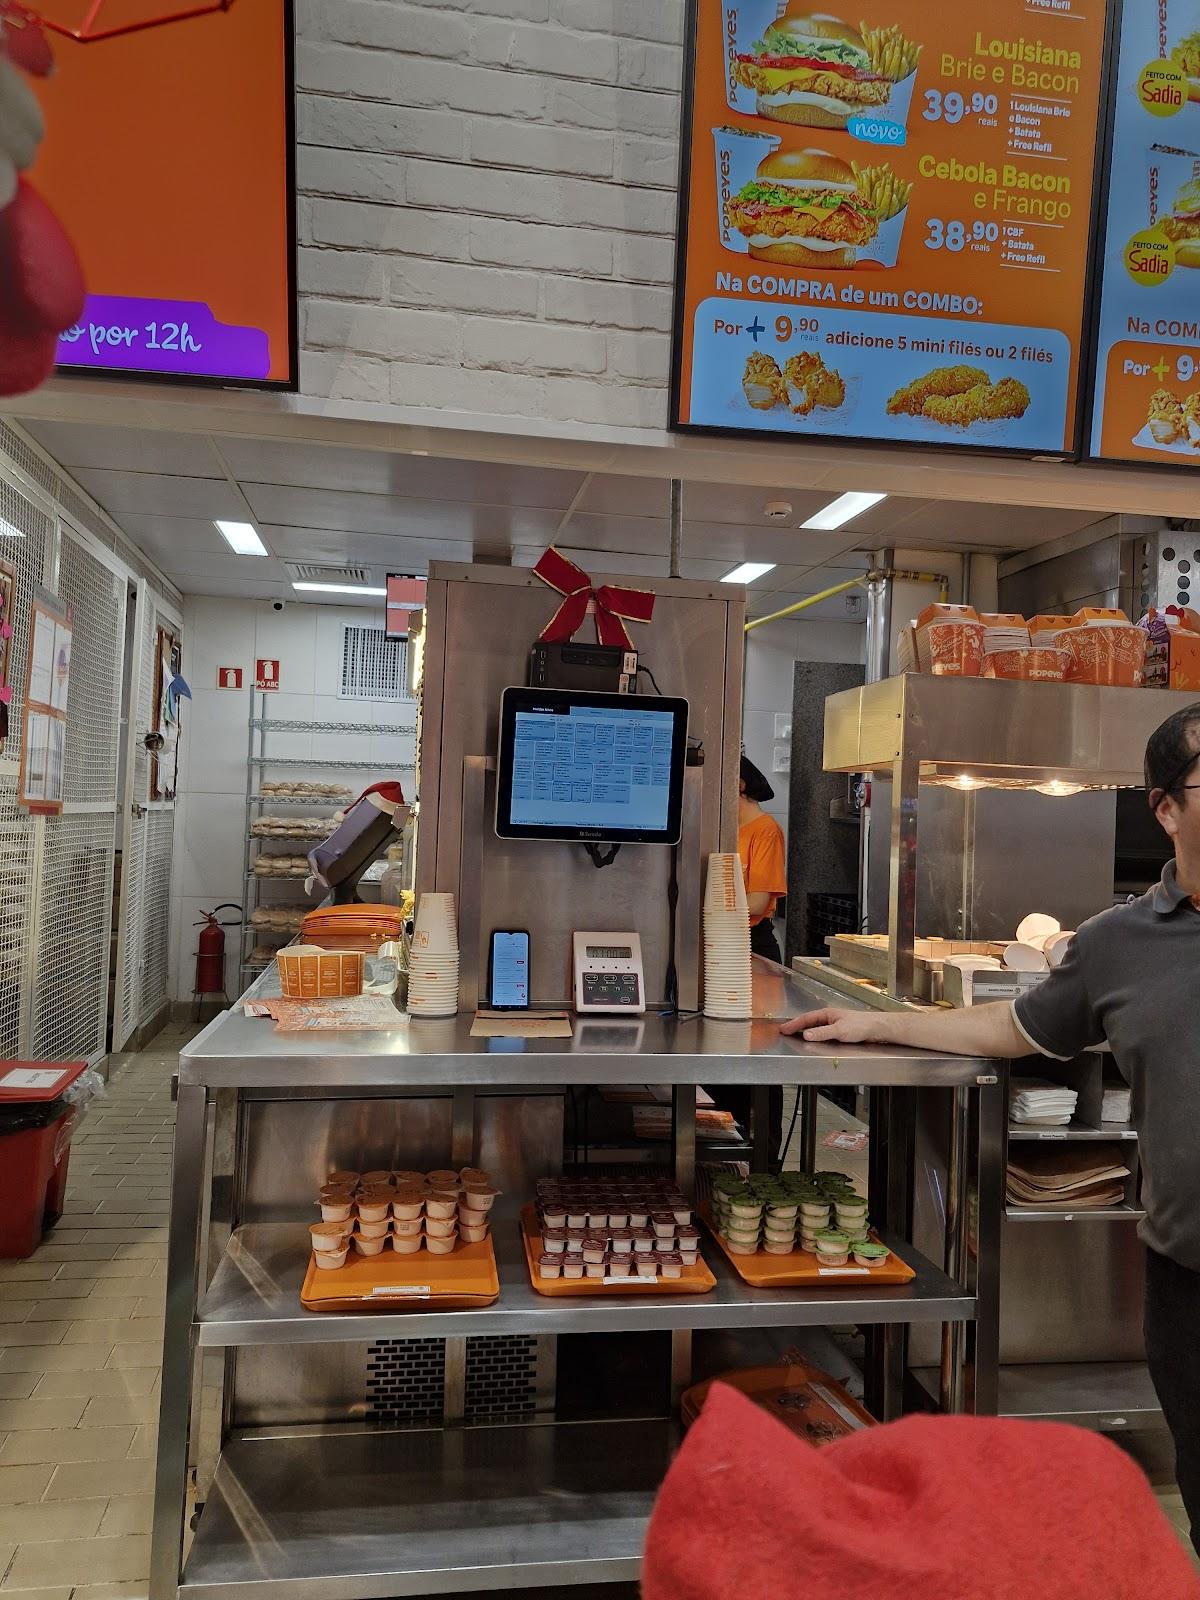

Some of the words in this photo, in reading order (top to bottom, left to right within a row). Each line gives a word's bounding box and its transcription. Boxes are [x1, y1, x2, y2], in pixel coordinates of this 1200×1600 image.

[975, 31, 1082, 70] Louisiana
[940, 53, 986, 81] Brie
[992, 66, 1005, 83] e
[1011, 64, 1080, 94] Bacon
[1146, 71, 1165, 79] FEITO
[1165, 73, 1182, 81] COM
[1142, 79, 1182, 105] Sadia
[921, 88, 998, 125] 39,90
[1009, 101, 1014, 110] 1
[1014, 101, 1053, 116] Louisiana
[1054, 107, 1071, 118] Brie
[855, 121, 902, 141] novo
[978, 117, 998, 127] reais
[1015, 114, 1041, 126] Bacon
[1014, 127, 1041, 139] Batata
[1013, 139, 1033, 150] Free
[1033, 141, 1052, 152] Refil
[918, 154, 998, 186] Cebola
[1002, 164, 1071, 194] Bacon
[973, 191, 987, 209] e
[993, 188, 1072, 221] Frango
[924, 218, 999, 252] 38,90
[1007, 227, 1024, 237] CBF
[970, 243, 990, 252] reais
[1007, 240, 1034, 251] Batata
[1133, 241, 1152, 249] FEITO
[1152, 243, 1169, 251] COM
[1007, 251, 1026, 263] Free
[1026, 253, 1045, 264] Refil
[1129, 250, 1169, 275] Sadia
[716, 271, 743, 292] Na
[747, 275, 837, 301] COMPRA
[840, 285, 865, 304] de
[868, 290, 899, 307] um
[903, 290, 983, 316] COMBO:
[89, 322, 139, 355] por
[145, 321, 202, 353] 12h
[714, 319, 743, 336] Por
[774, 315, 819, 343] 9,90
[800, 334, 819, 342] reais
[1127, 316, 1150, 335] Na
[1155, 319, 1200, 339] COM
[825, 331, 894, 349] adicione
[897, 336, 907, 350] 5
[911, 339, 945, 354] mini
[948, 340, 982, 357] filés
[985, 346, 1004, 359] ou
[1008, 346, 1017, 360] 2
[1020, 346, 1053, 363] filés
[1123, 359, 1150, 376] Por
[1176, 354, 1200, 382] 9,
